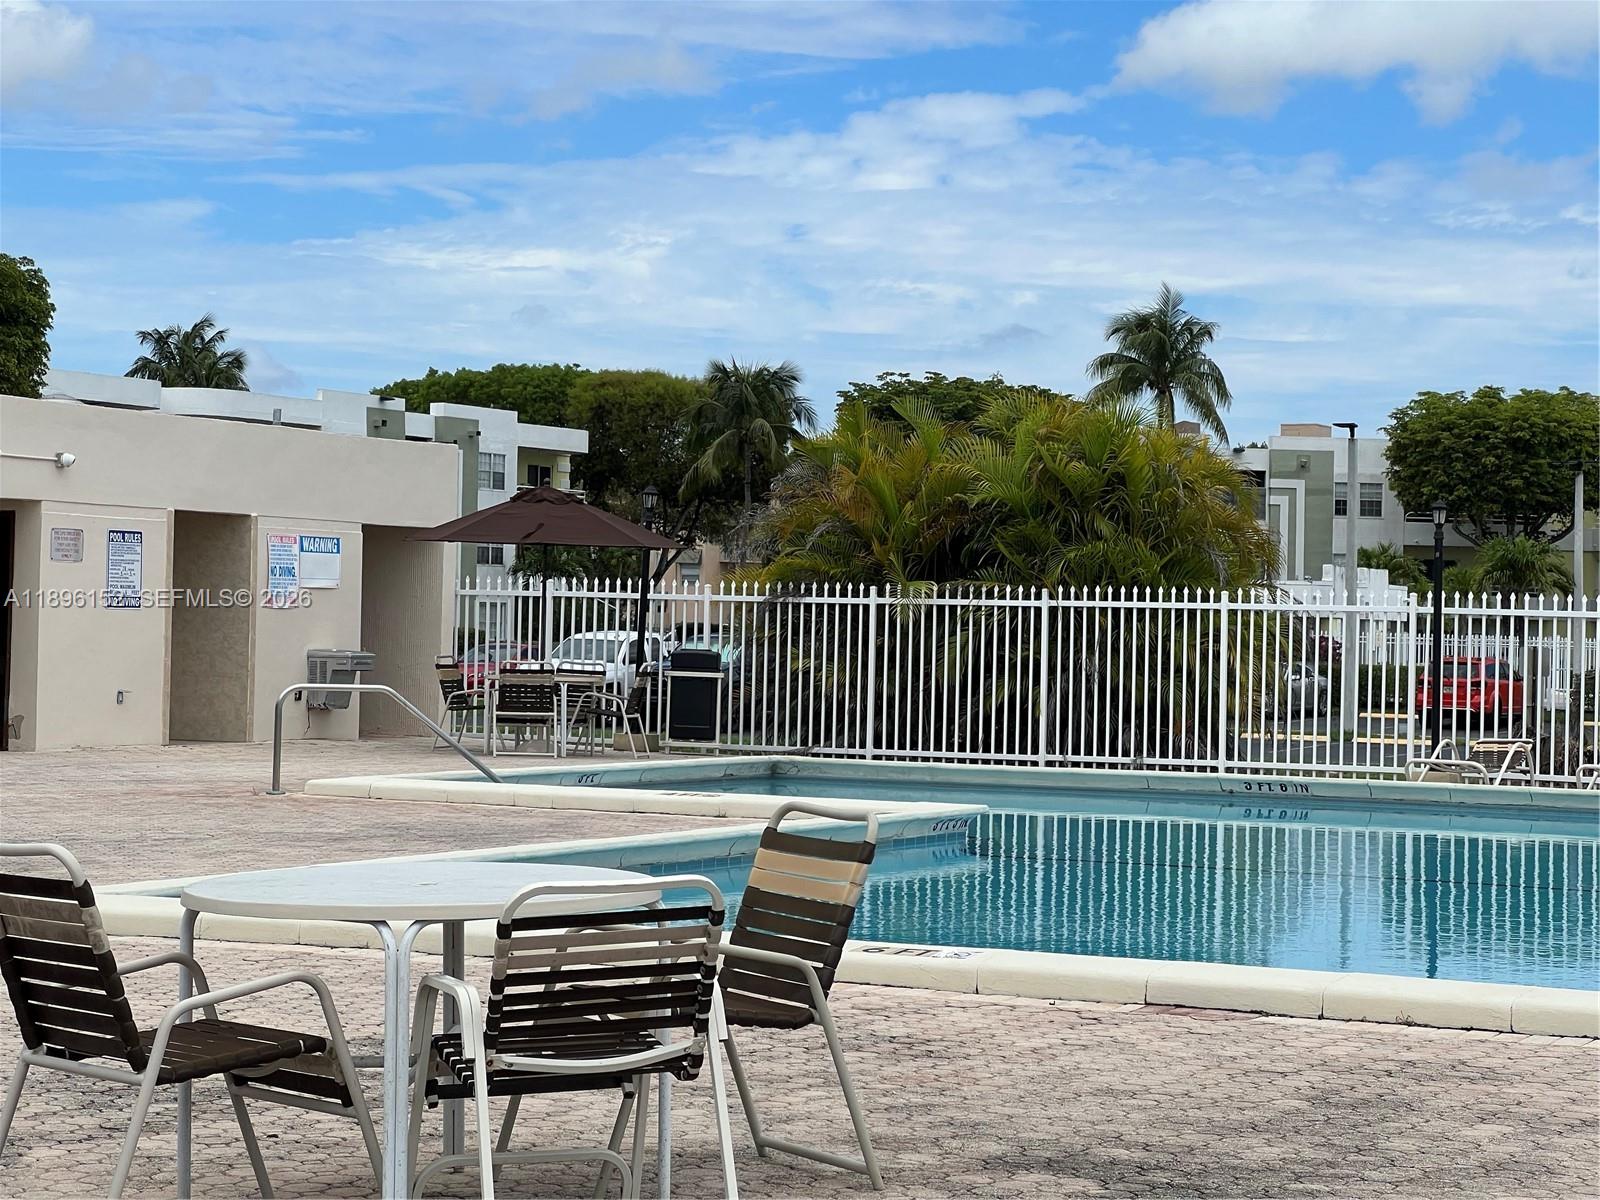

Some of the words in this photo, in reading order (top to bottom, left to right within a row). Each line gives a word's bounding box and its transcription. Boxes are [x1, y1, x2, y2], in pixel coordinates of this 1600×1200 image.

[110, 532, 124, 542] POOL
[124, 533, 142, 543] RULES
[302, 537, 338, 553] WARNING
[270, 566, 277, 577] NO
[1294, 784, 1310, 793] IN
